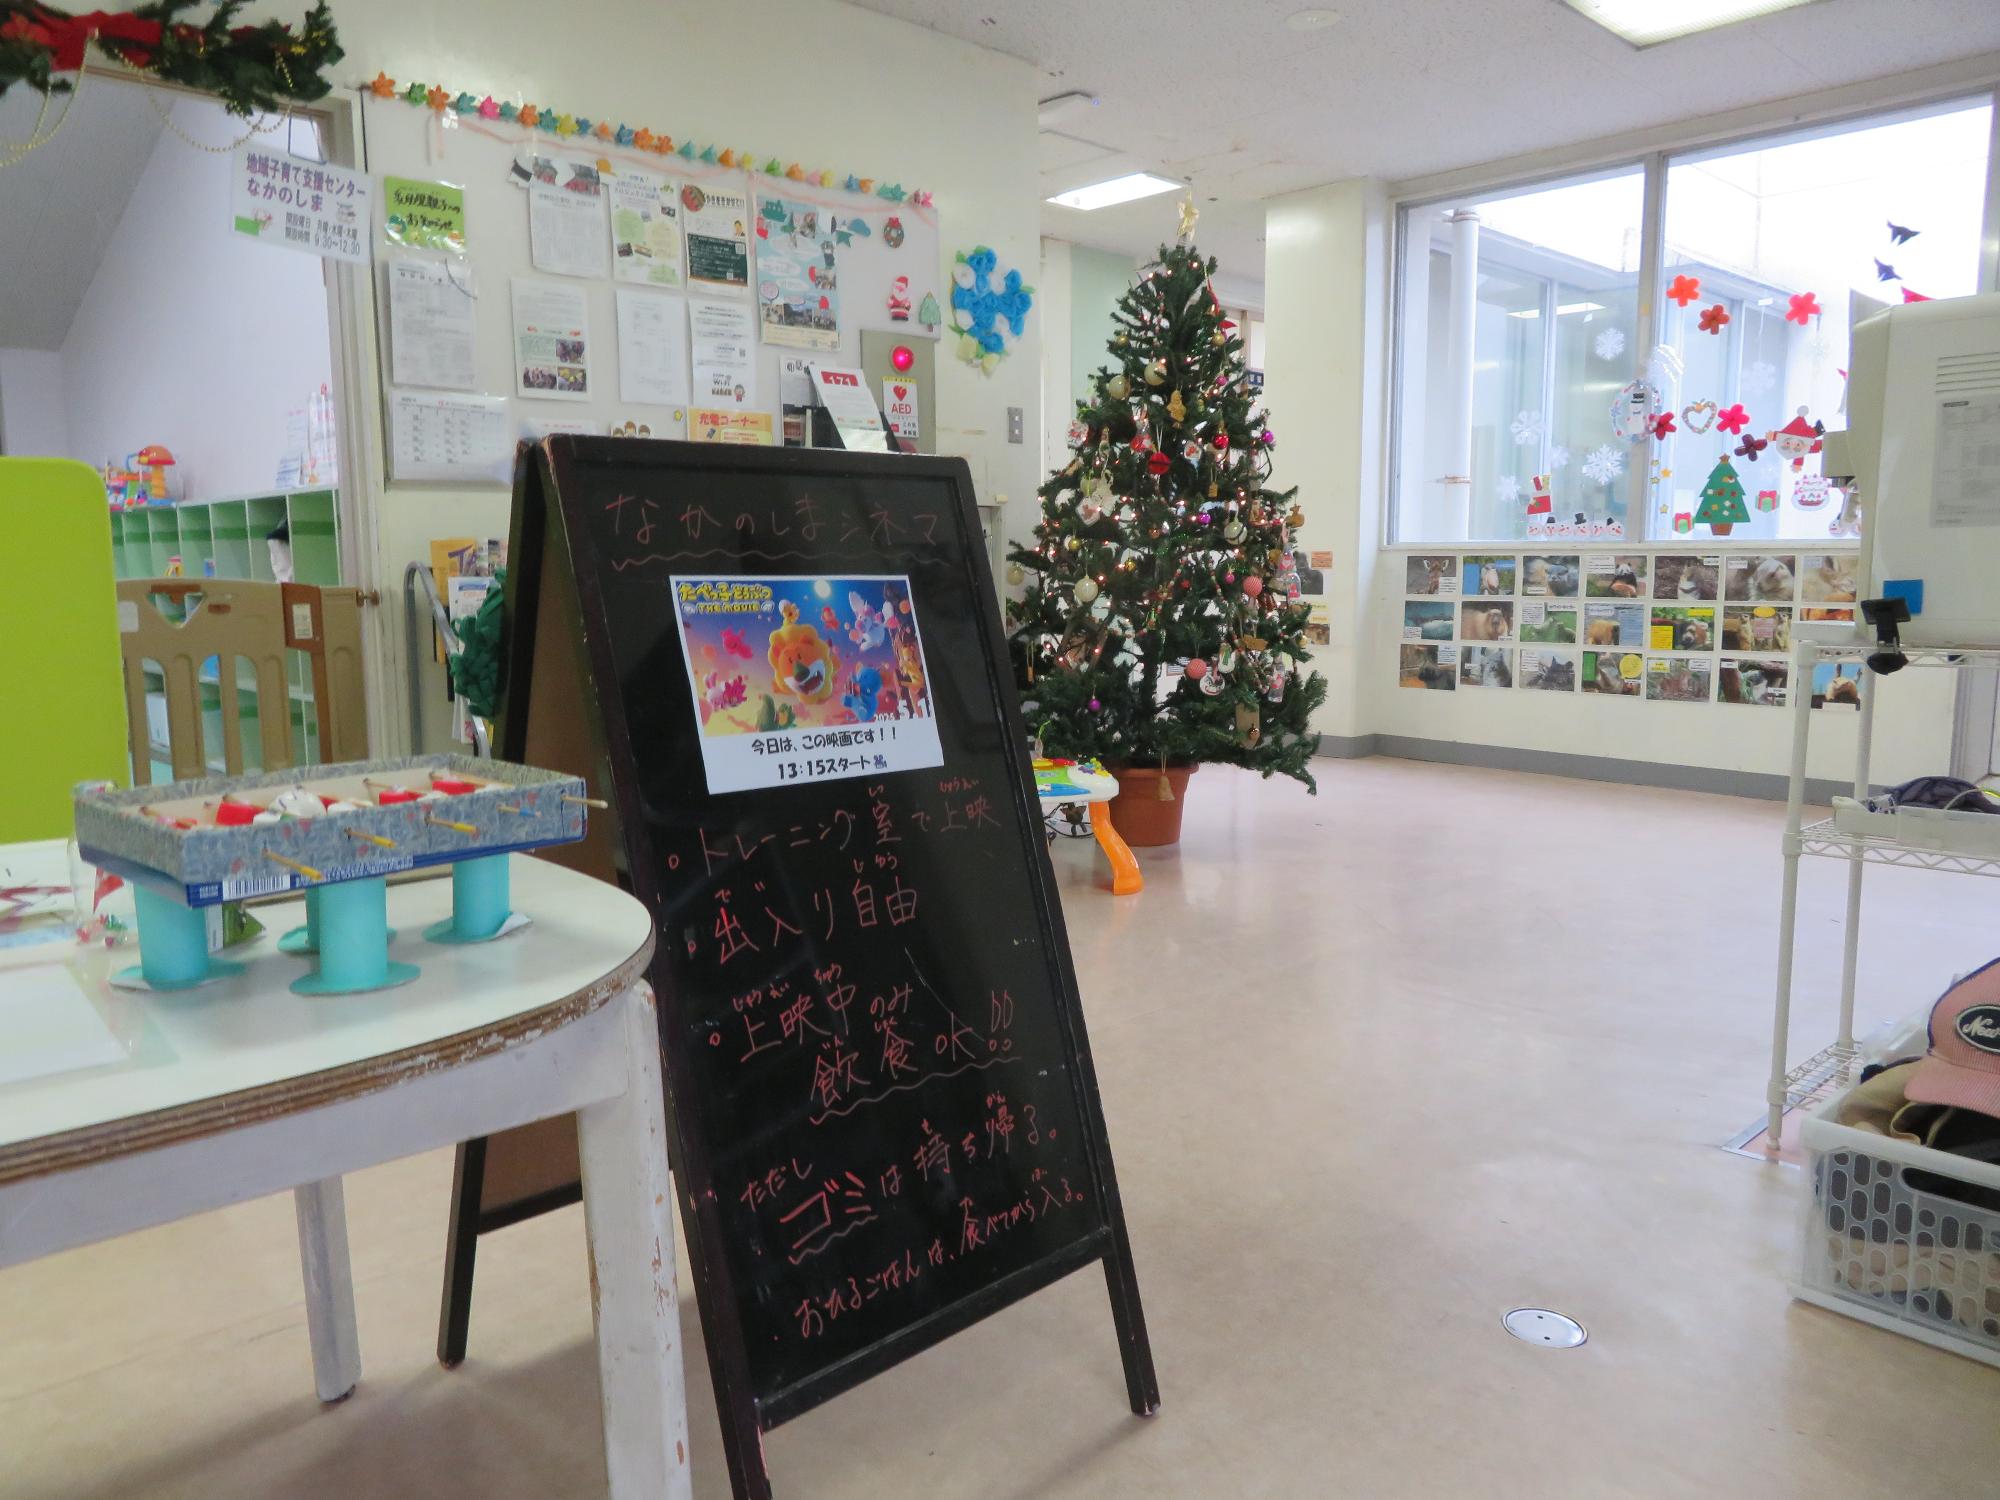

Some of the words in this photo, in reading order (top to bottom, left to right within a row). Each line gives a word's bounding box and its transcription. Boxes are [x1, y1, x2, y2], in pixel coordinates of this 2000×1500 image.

[246, 152, 366, 198] 地域子育て支援センター
[247, 177, 322, 212] なかのしま
[698, 412, 759, 428] 充電コーナー
[891, 403, 912, 415] AED
[605, 494, 938, 547] なかのしまシネマ
[698, 602, 721, 613] THE
[723, 602, 760, 613] MOVIE
[712, 875, 919, 964] 出入り自由
